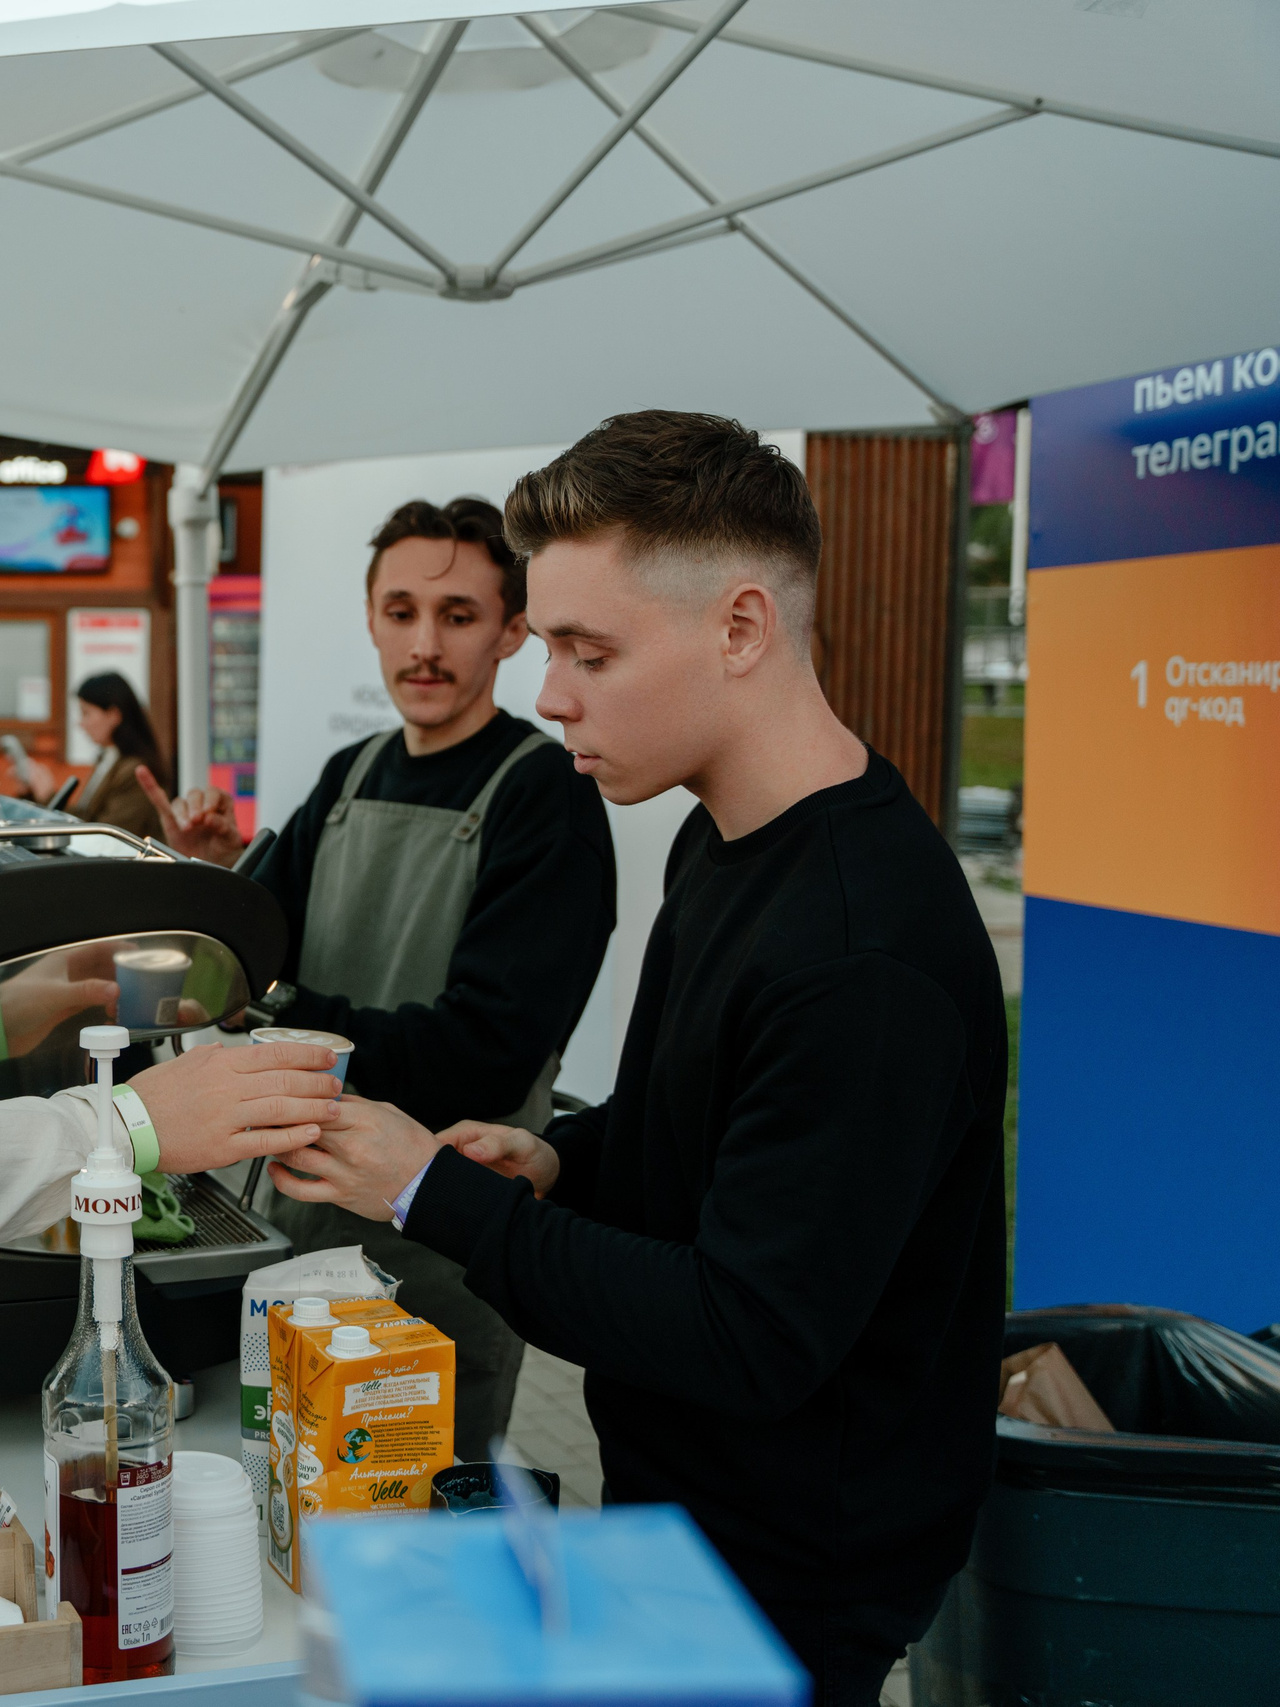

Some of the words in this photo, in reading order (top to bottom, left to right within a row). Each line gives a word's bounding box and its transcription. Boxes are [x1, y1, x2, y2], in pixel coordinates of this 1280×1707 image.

[1133, 360, 1224, 414] пьем
[1132, 420, 1280, 479] телегра
[1131, 660, 1149, 708] 1
[1164, 696, 1246, 727] qr-код
[373, 1367, 391, 1376] Что
[394, 1359, 419, 1374] это?
[360, 1380, 382, 1393] Velle
[361, 1406, 414, 1427] Проблемы?
[349, 1463, 428, 1483] Альтернатива?
[368, 1480, 409, 1502] Velle
